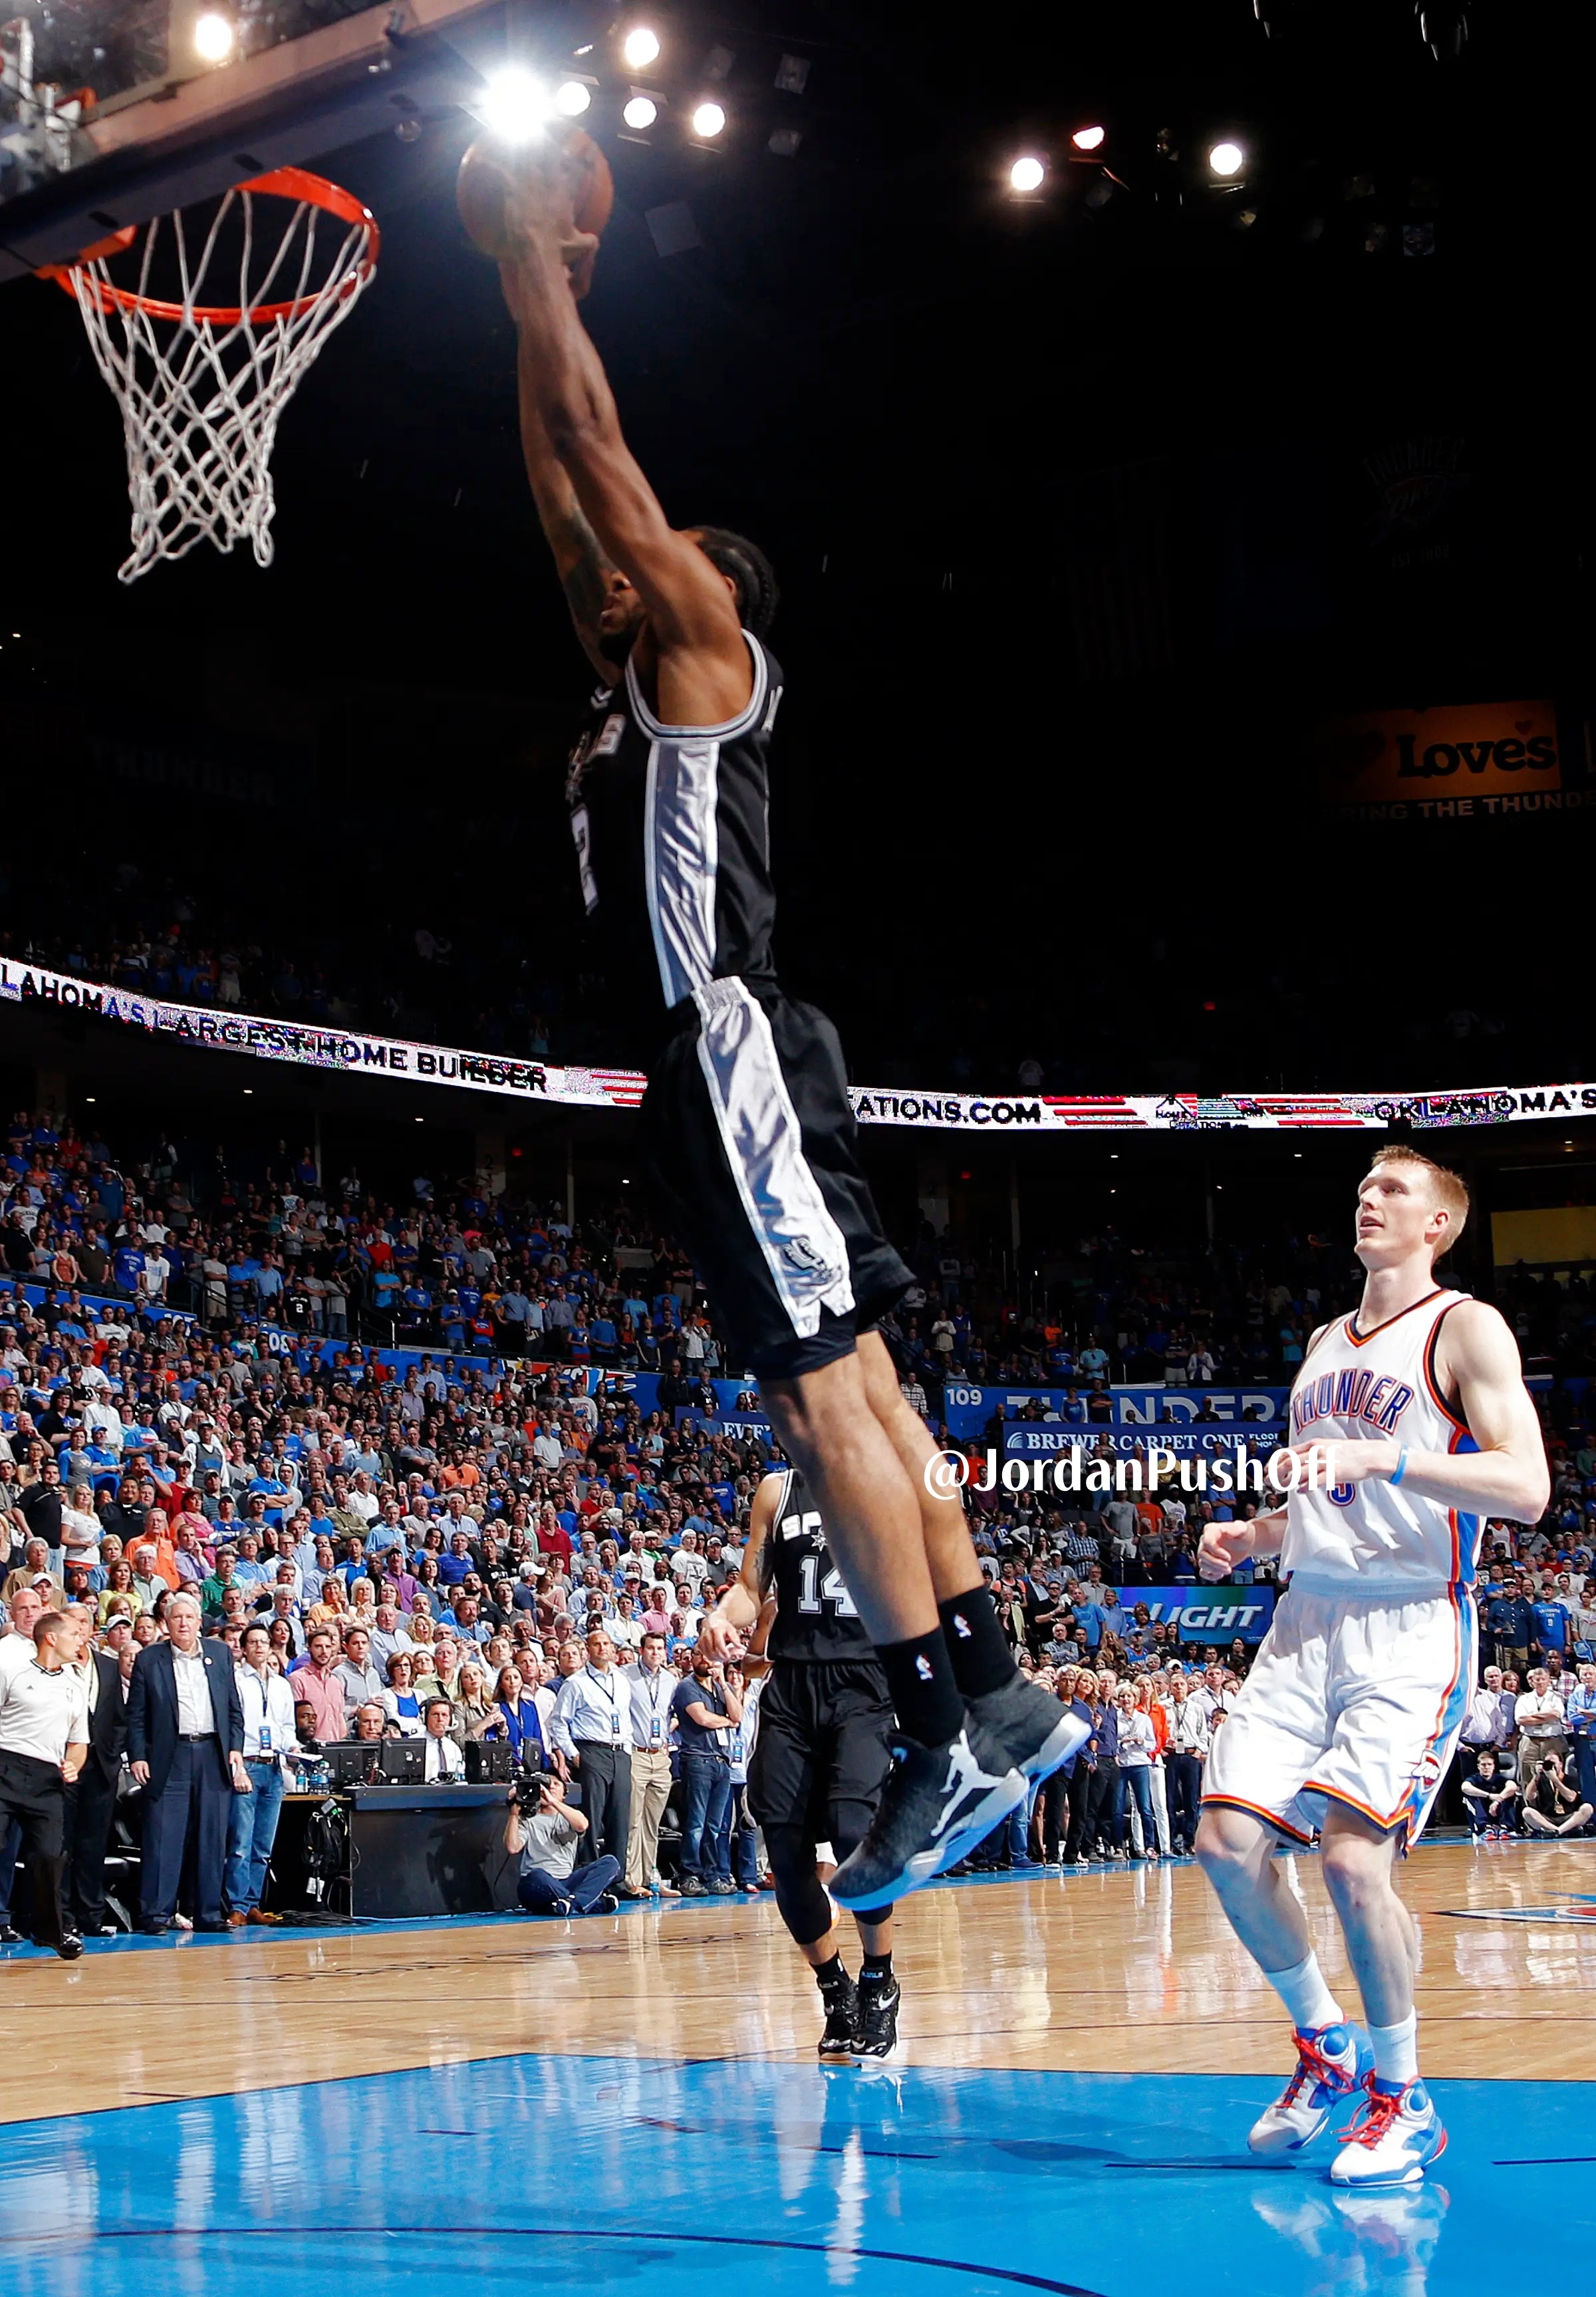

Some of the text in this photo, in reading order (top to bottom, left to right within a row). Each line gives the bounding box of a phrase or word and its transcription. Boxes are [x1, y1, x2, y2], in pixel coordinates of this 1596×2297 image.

[1418, 799, 1474, 819] THE
[315, 1033, 408, 1071] HOME
[849, 1095, 1041, 1124] ATIONS.COM
[947, 1388, 983, 1406] 109
[1290, 1368, 1414, 1435] THUNDER
[1025, 1432, 1246, 1450] BREWER CARPET ONE
[797, 1554, 861, 1617] 14
